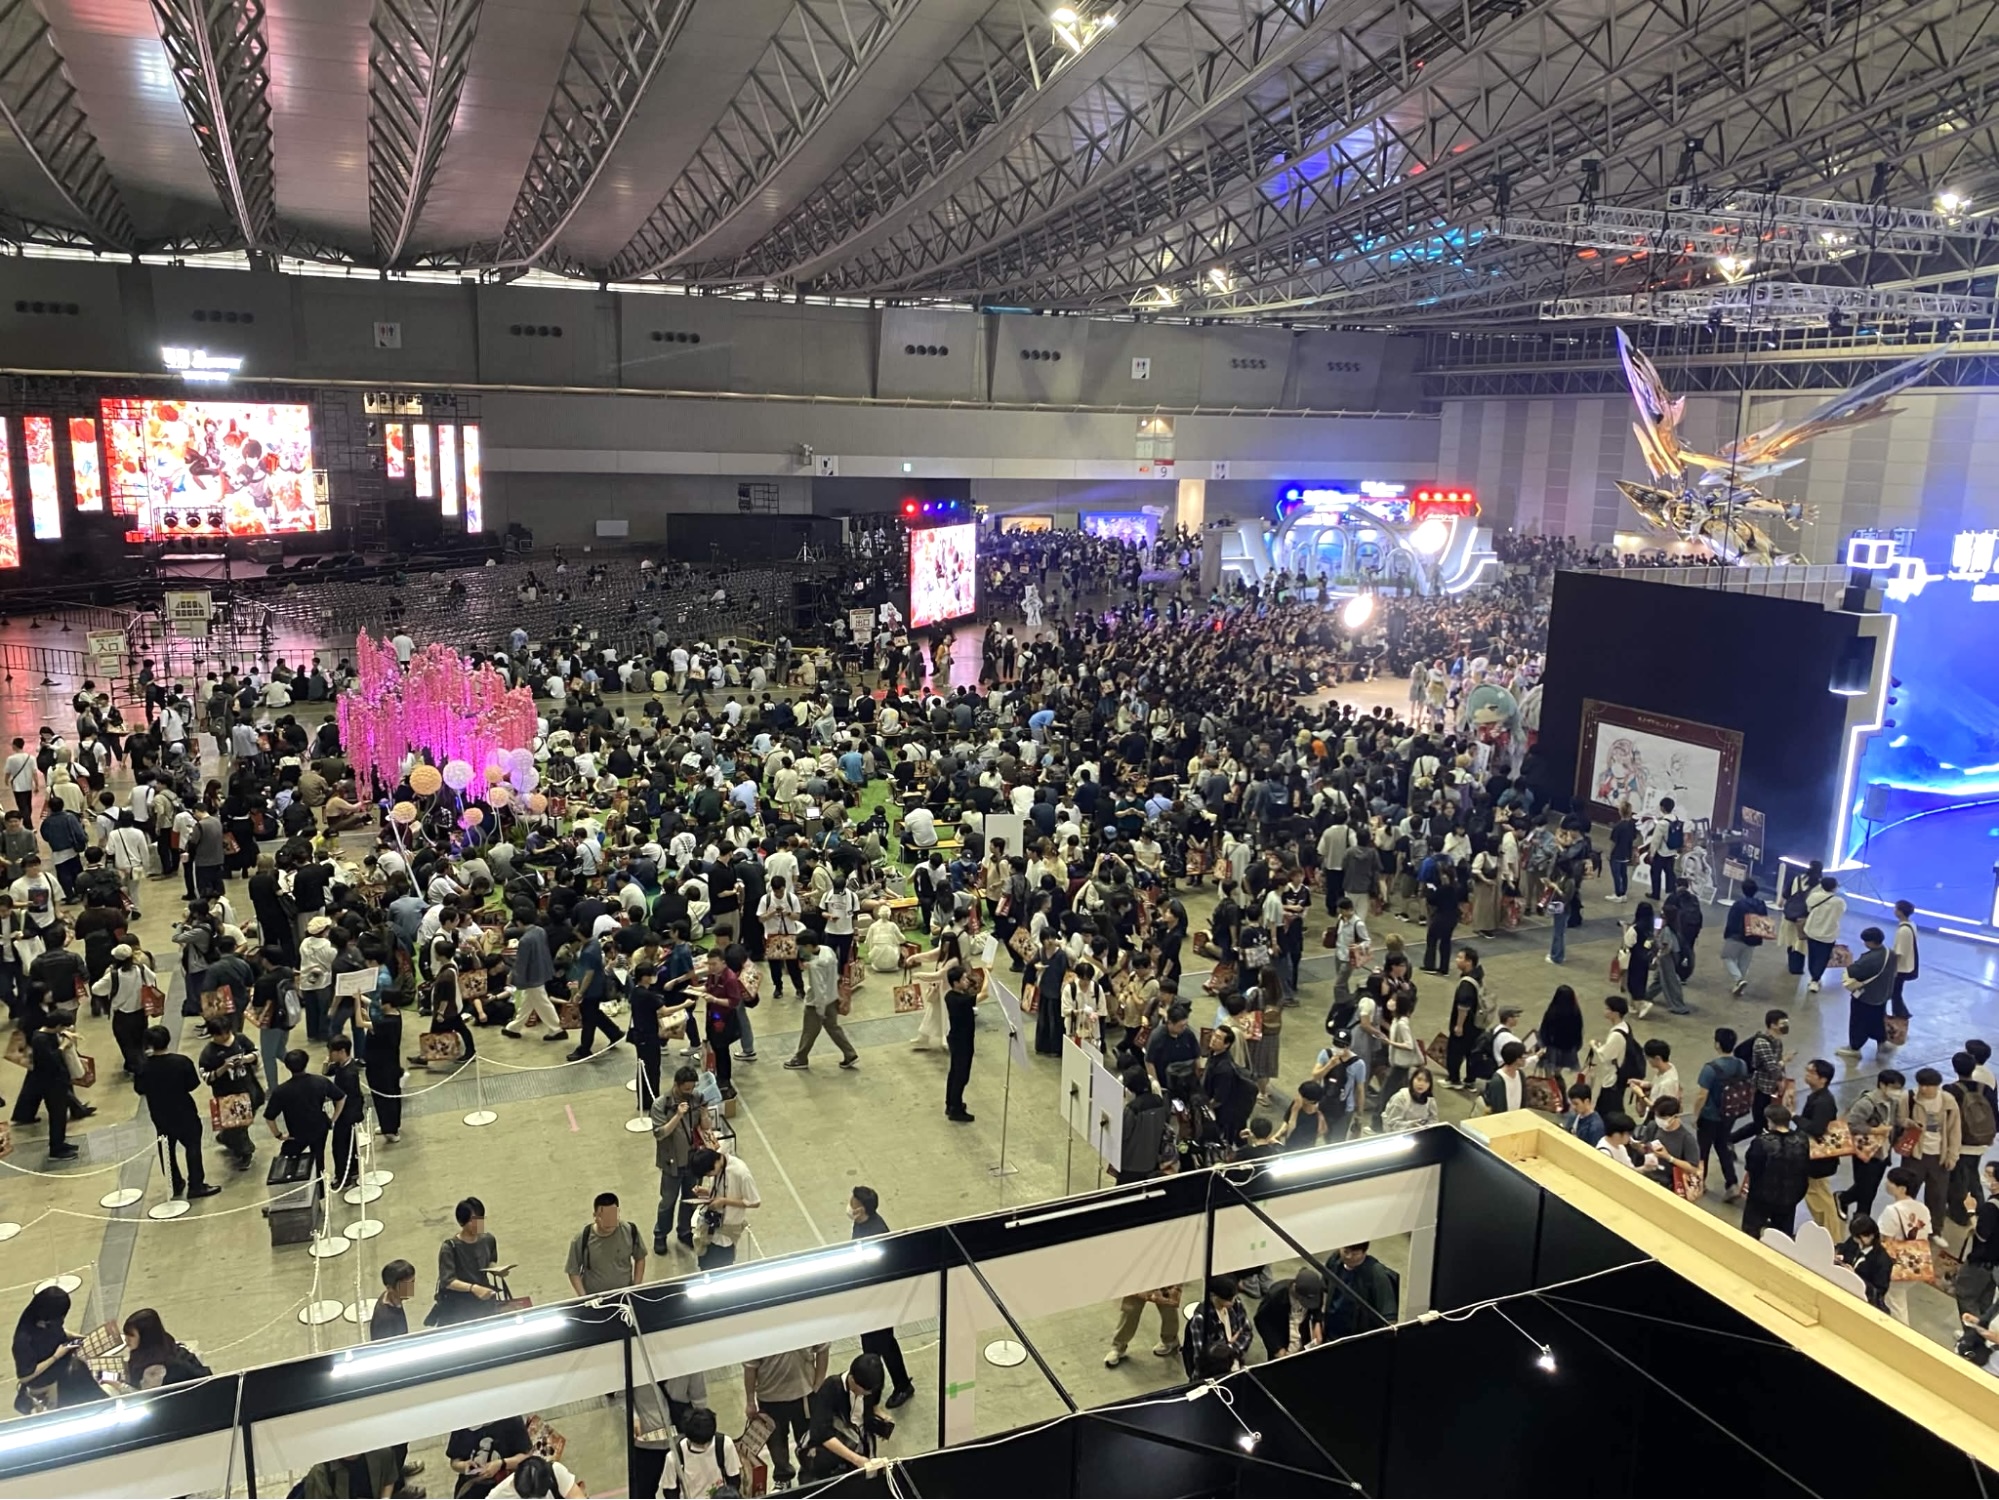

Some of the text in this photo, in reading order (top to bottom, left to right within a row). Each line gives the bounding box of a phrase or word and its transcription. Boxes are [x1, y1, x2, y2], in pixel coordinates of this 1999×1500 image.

[1160, 466, 1168, 478] 9
[855, 619, 870, 627] 出口
[97, 642, 119, 652] 入口
